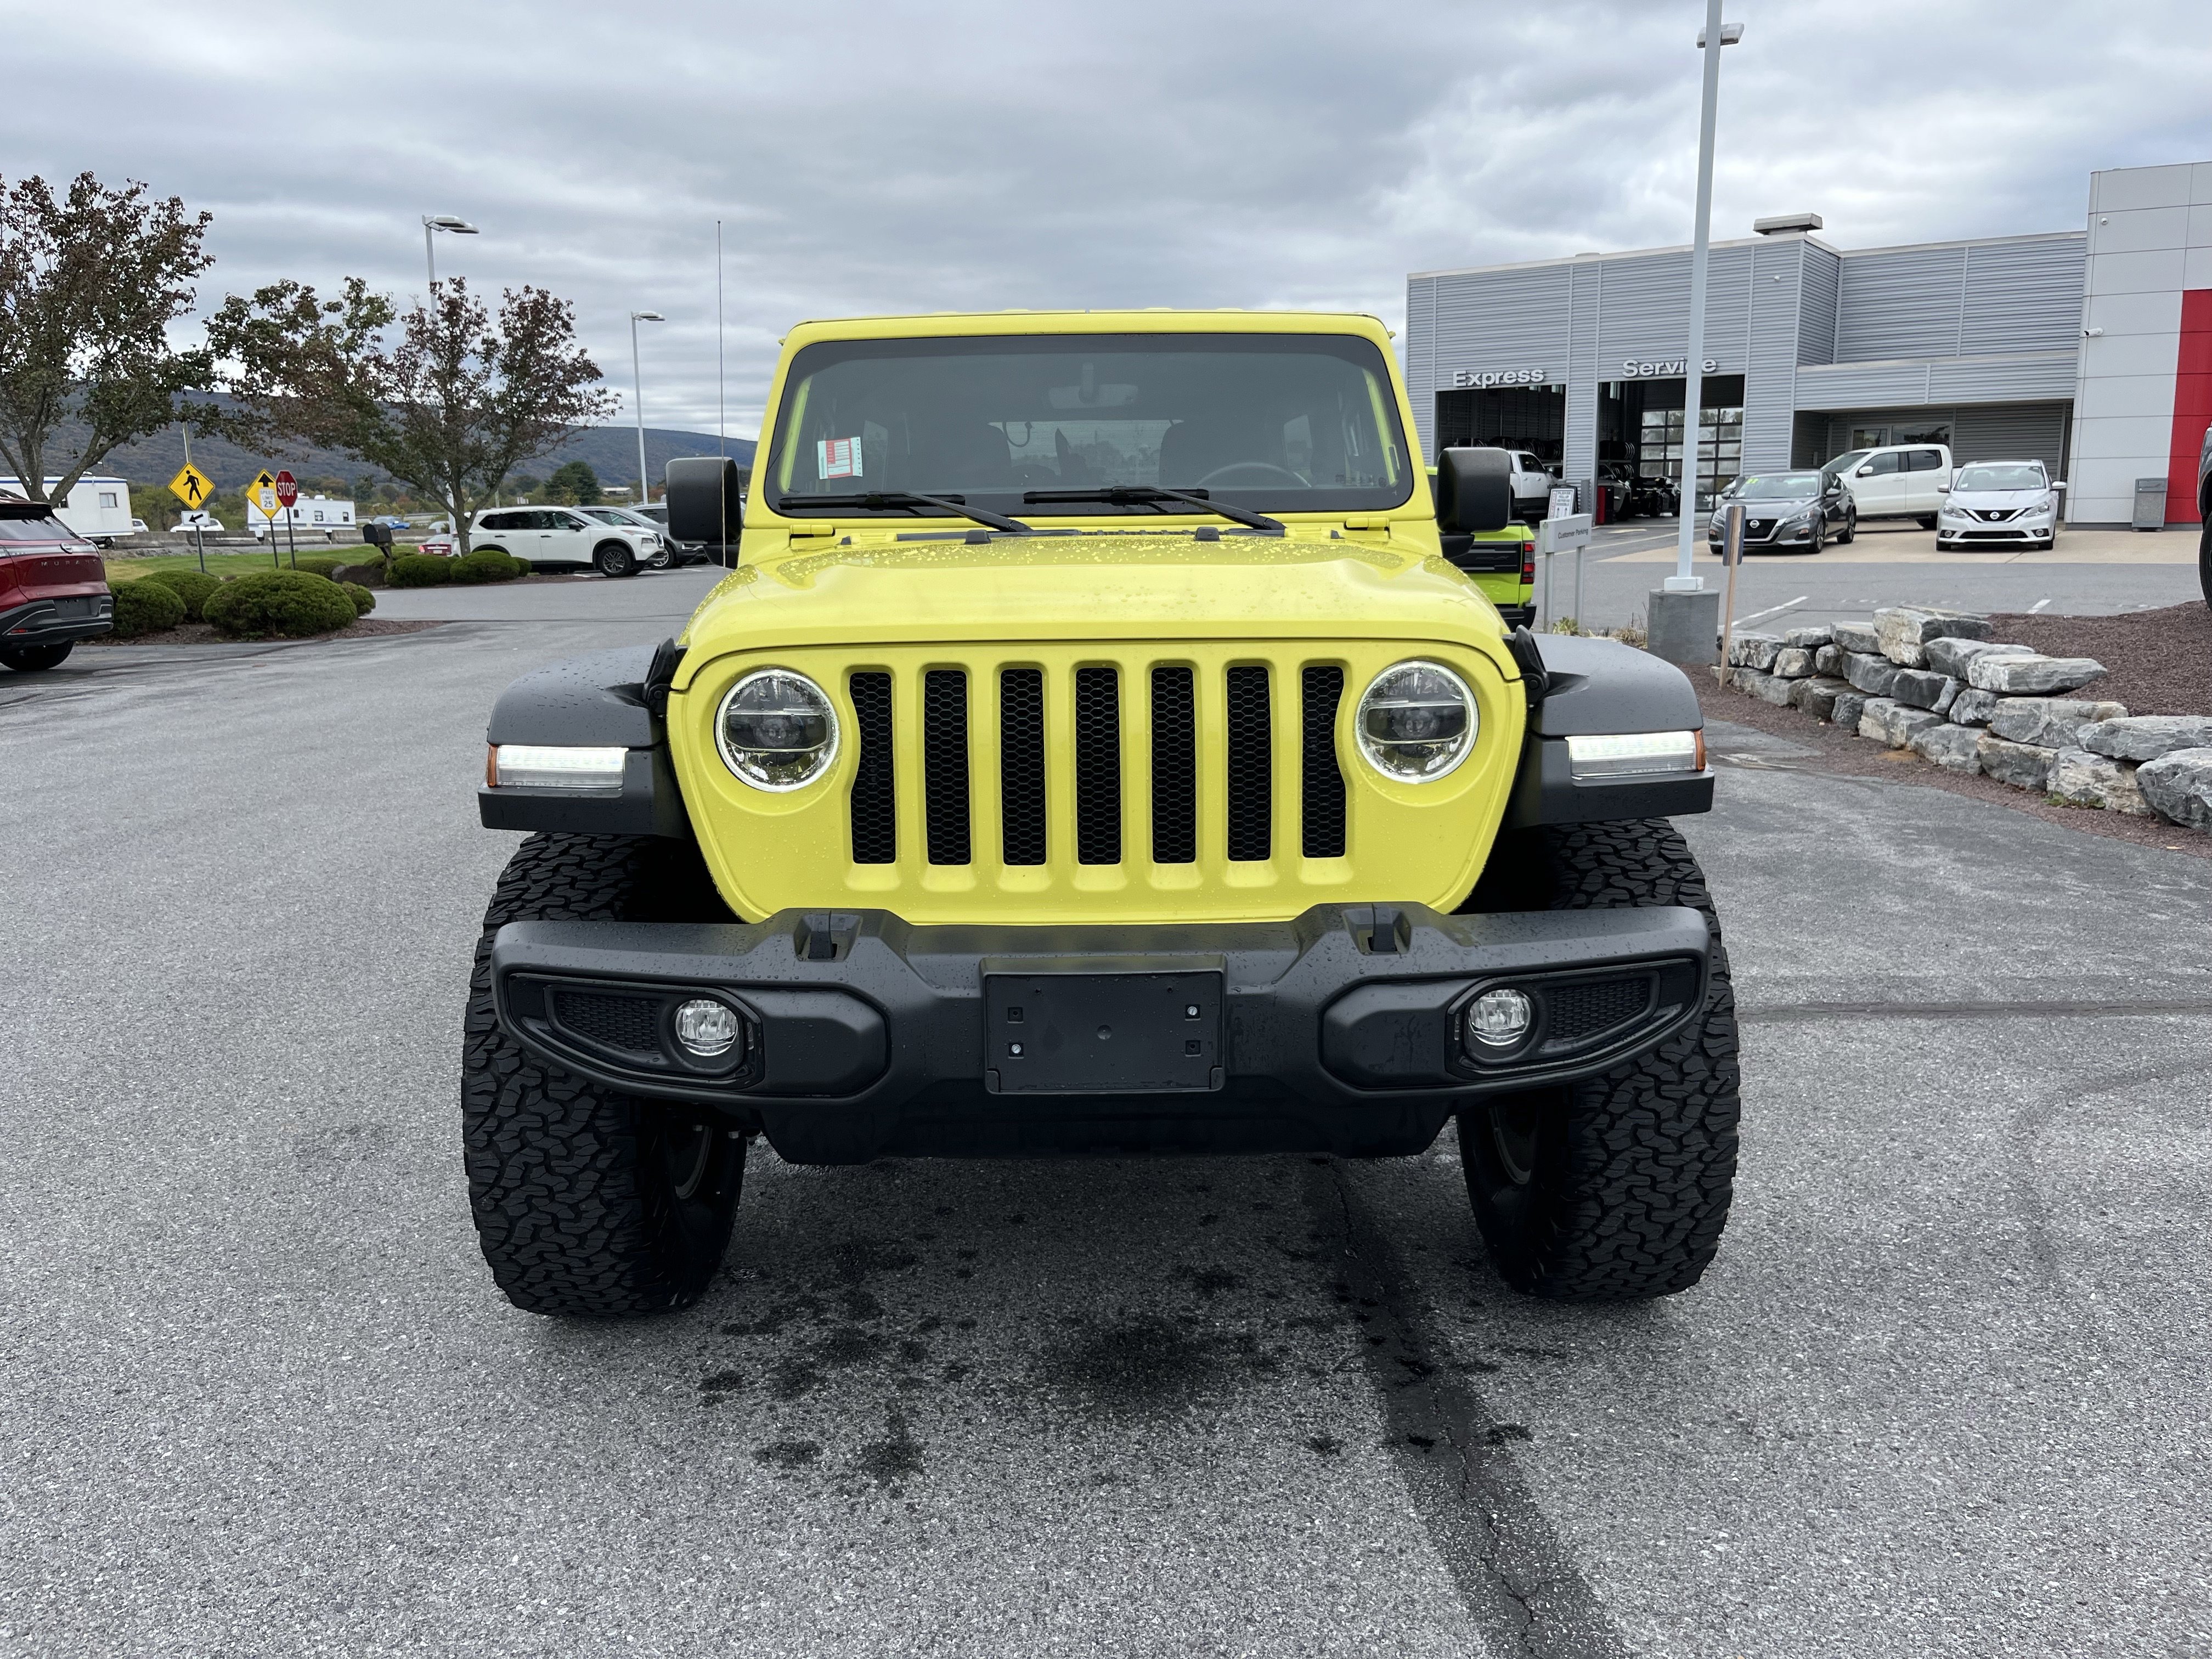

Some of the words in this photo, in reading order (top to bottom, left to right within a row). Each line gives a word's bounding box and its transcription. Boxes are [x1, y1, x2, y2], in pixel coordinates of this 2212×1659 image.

[1622, 357, 1717, 377] Servie
[1453, 369, 1544, 390] Express
[278, 482, 296, 496] STOP
